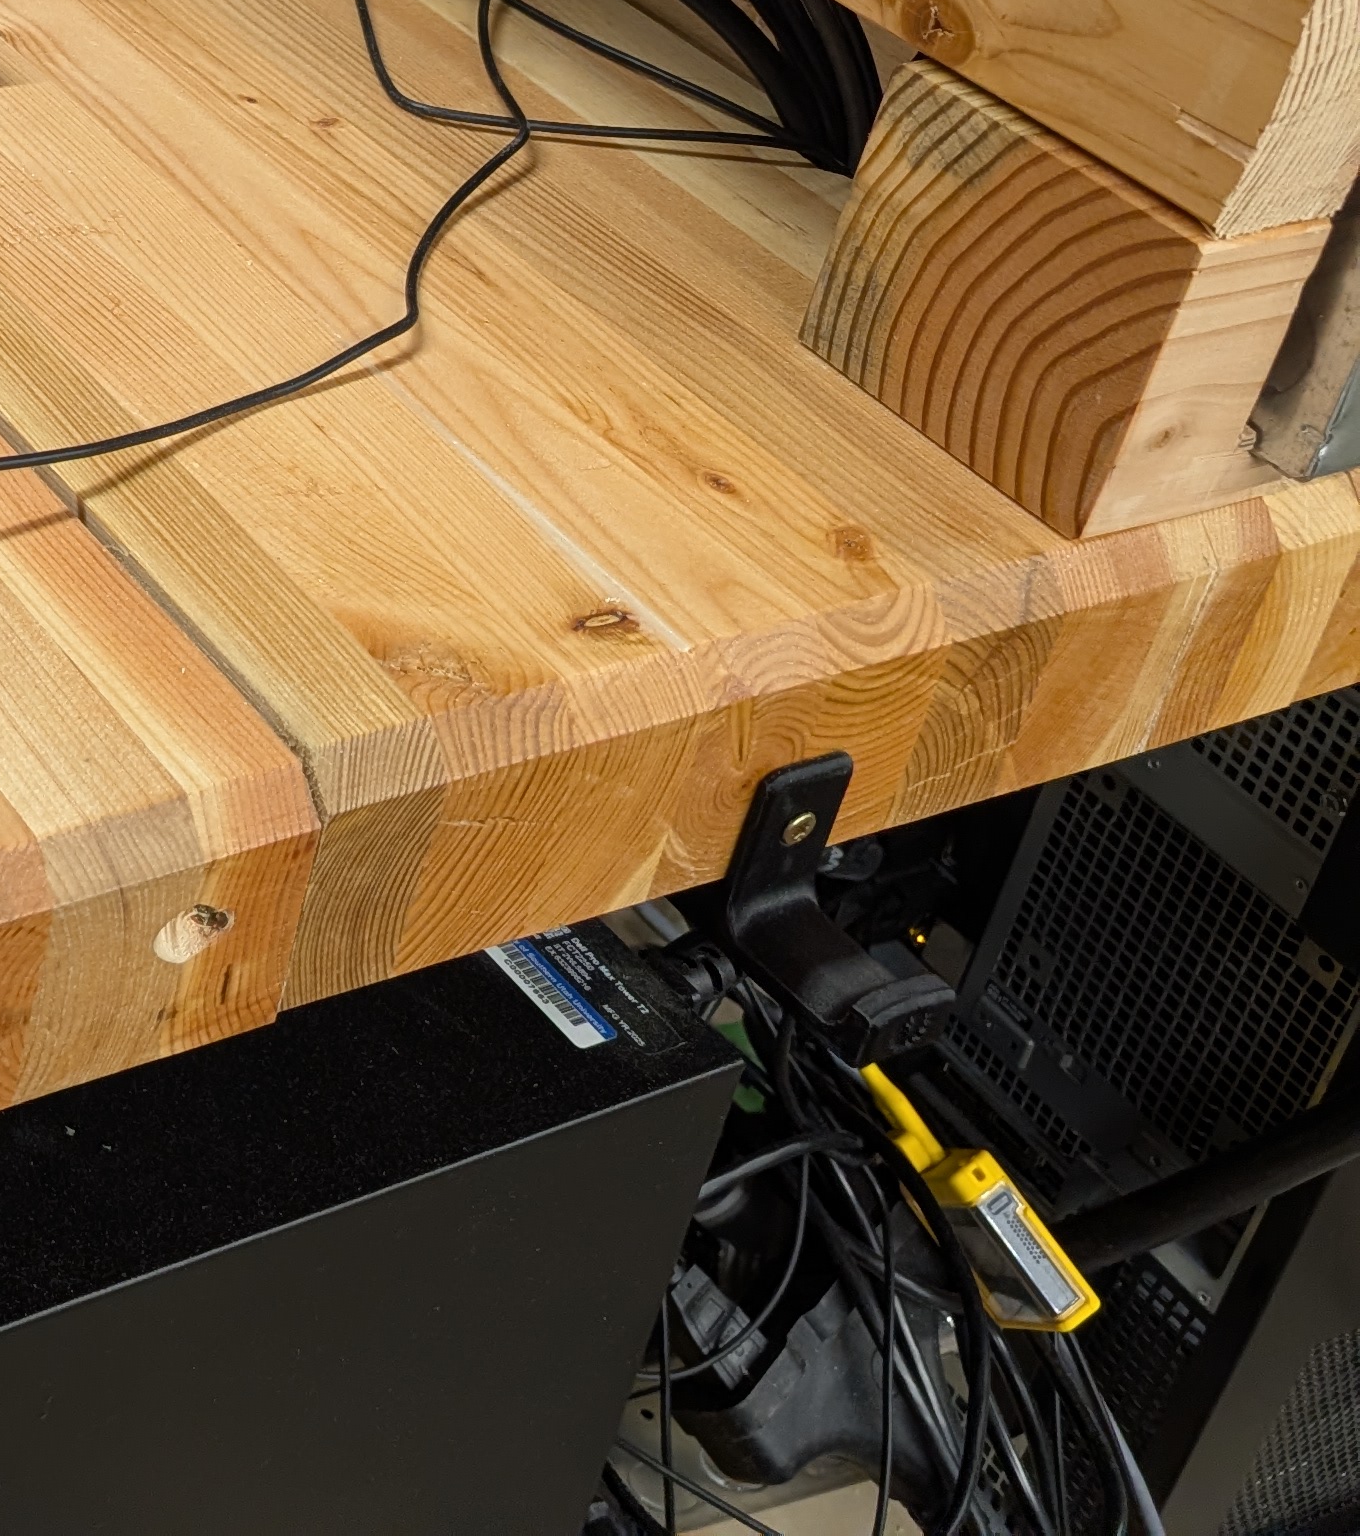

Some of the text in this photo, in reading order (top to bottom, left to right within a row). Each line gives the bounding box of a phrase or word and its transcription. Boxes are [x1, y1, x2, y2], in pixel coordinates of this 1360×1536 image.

[519, 944, 528, 954] of
[527, 952, 557, 984] Southern
[557, 982, 572, 1000] Utah
[572, 999, 608, 1034] University
[570, 937, 588, 952] Dell
[587, 949, 600, 965] Pro
[598, 965, 616, 982] Max
[615, 982, 638, 1004] Tower
[637, 1002, 649, 1014] T2
[602, 1004, 620, 1020] MFG
